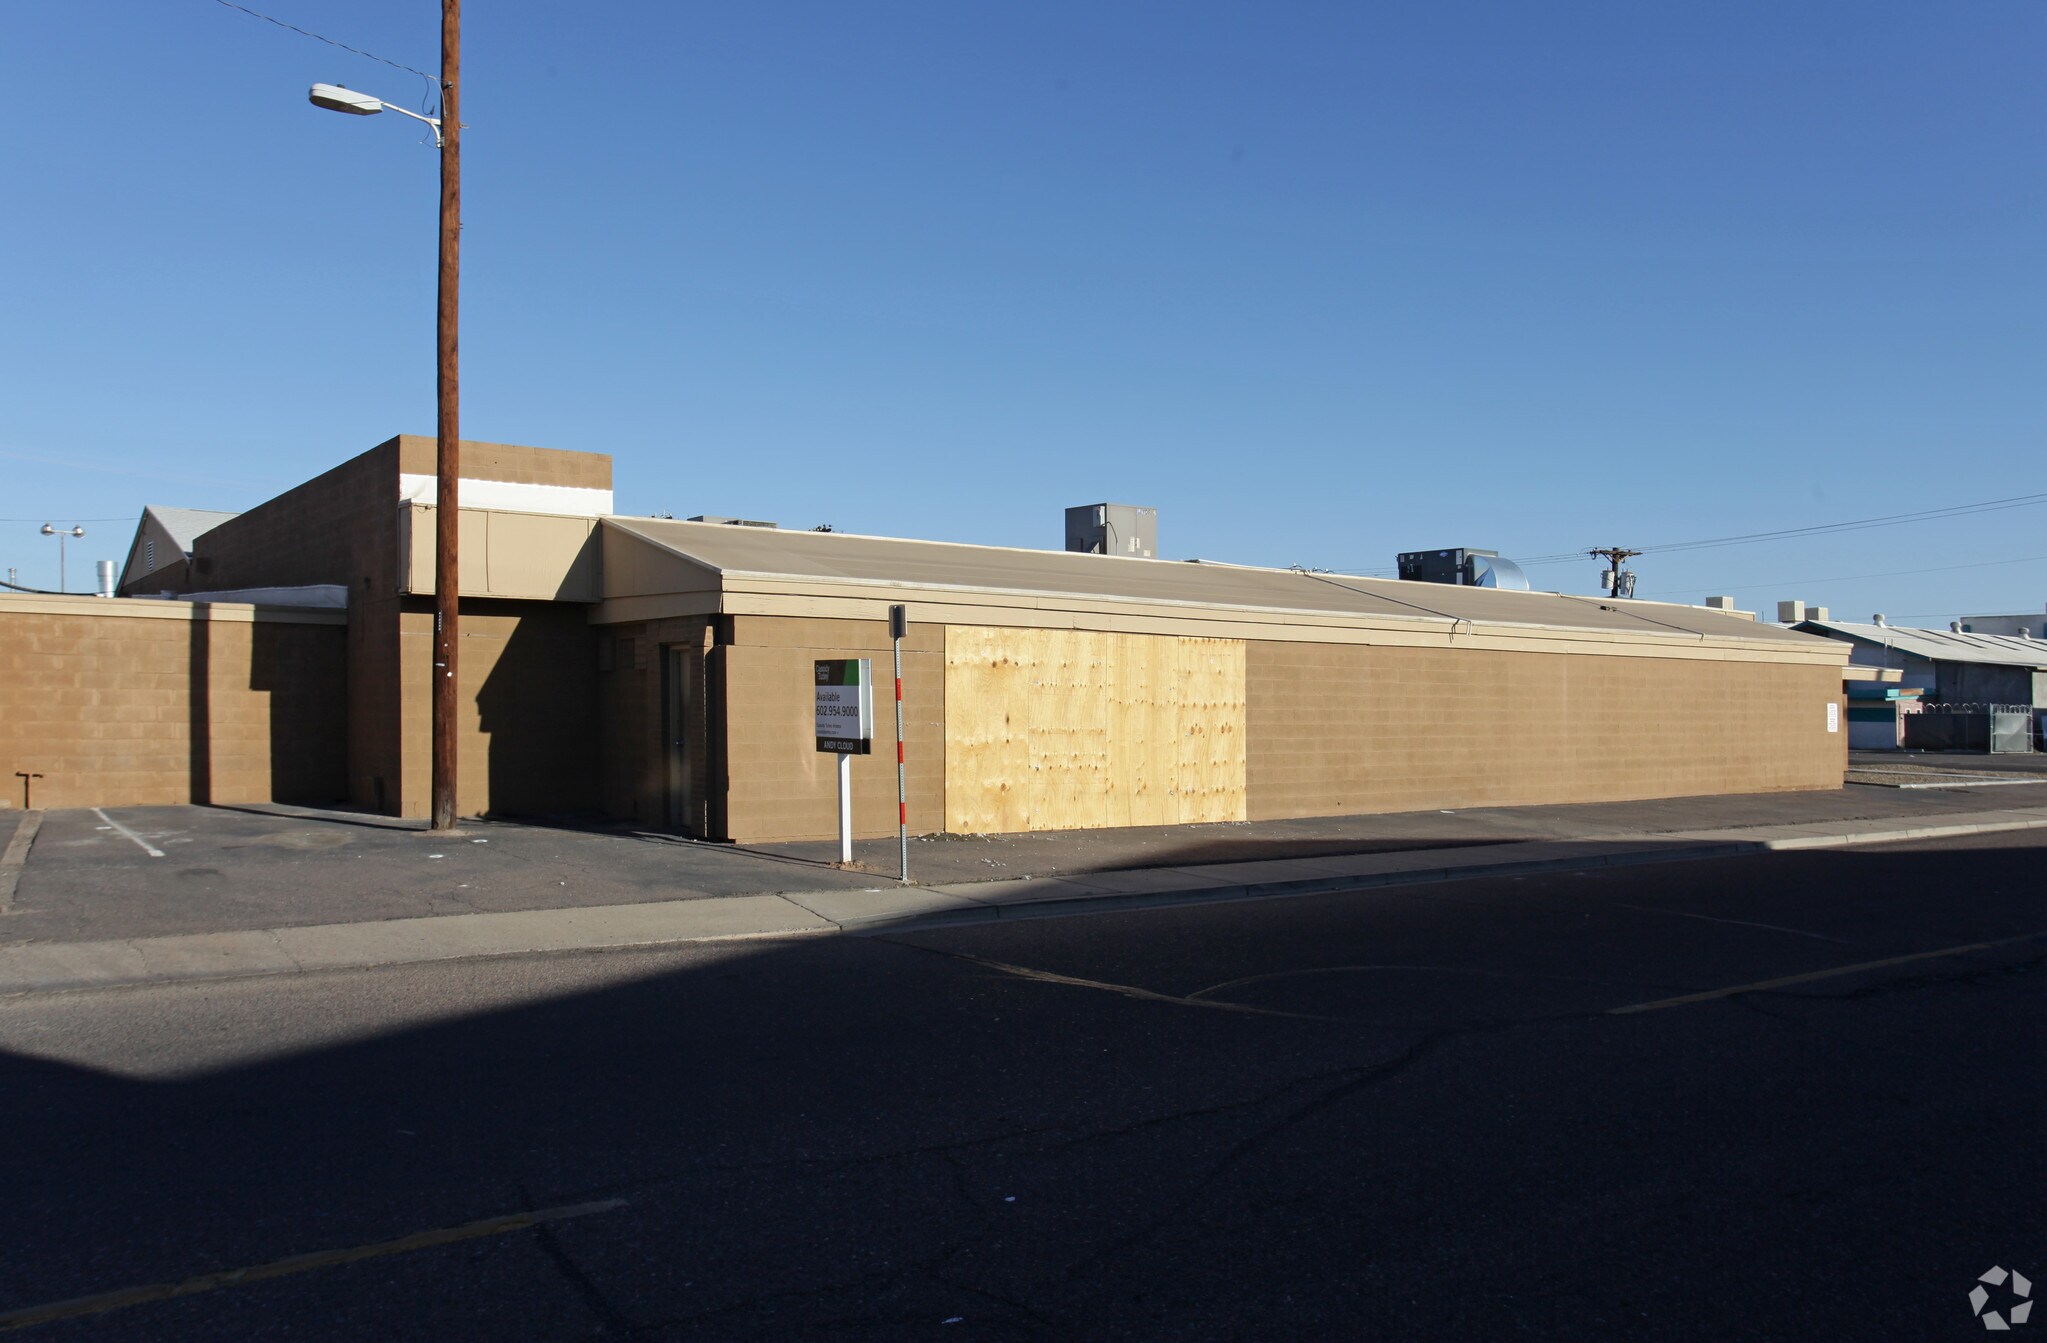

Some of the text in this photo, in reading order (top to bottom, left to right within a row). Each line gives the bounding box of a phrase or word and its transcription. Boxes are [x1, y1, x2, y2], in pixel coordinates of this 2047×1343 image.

[816, 691, 840, 702] Available
[816, 705, 858, 717] 602.954.9000
[823, 740, 854, 751] ANDY CLOUD
